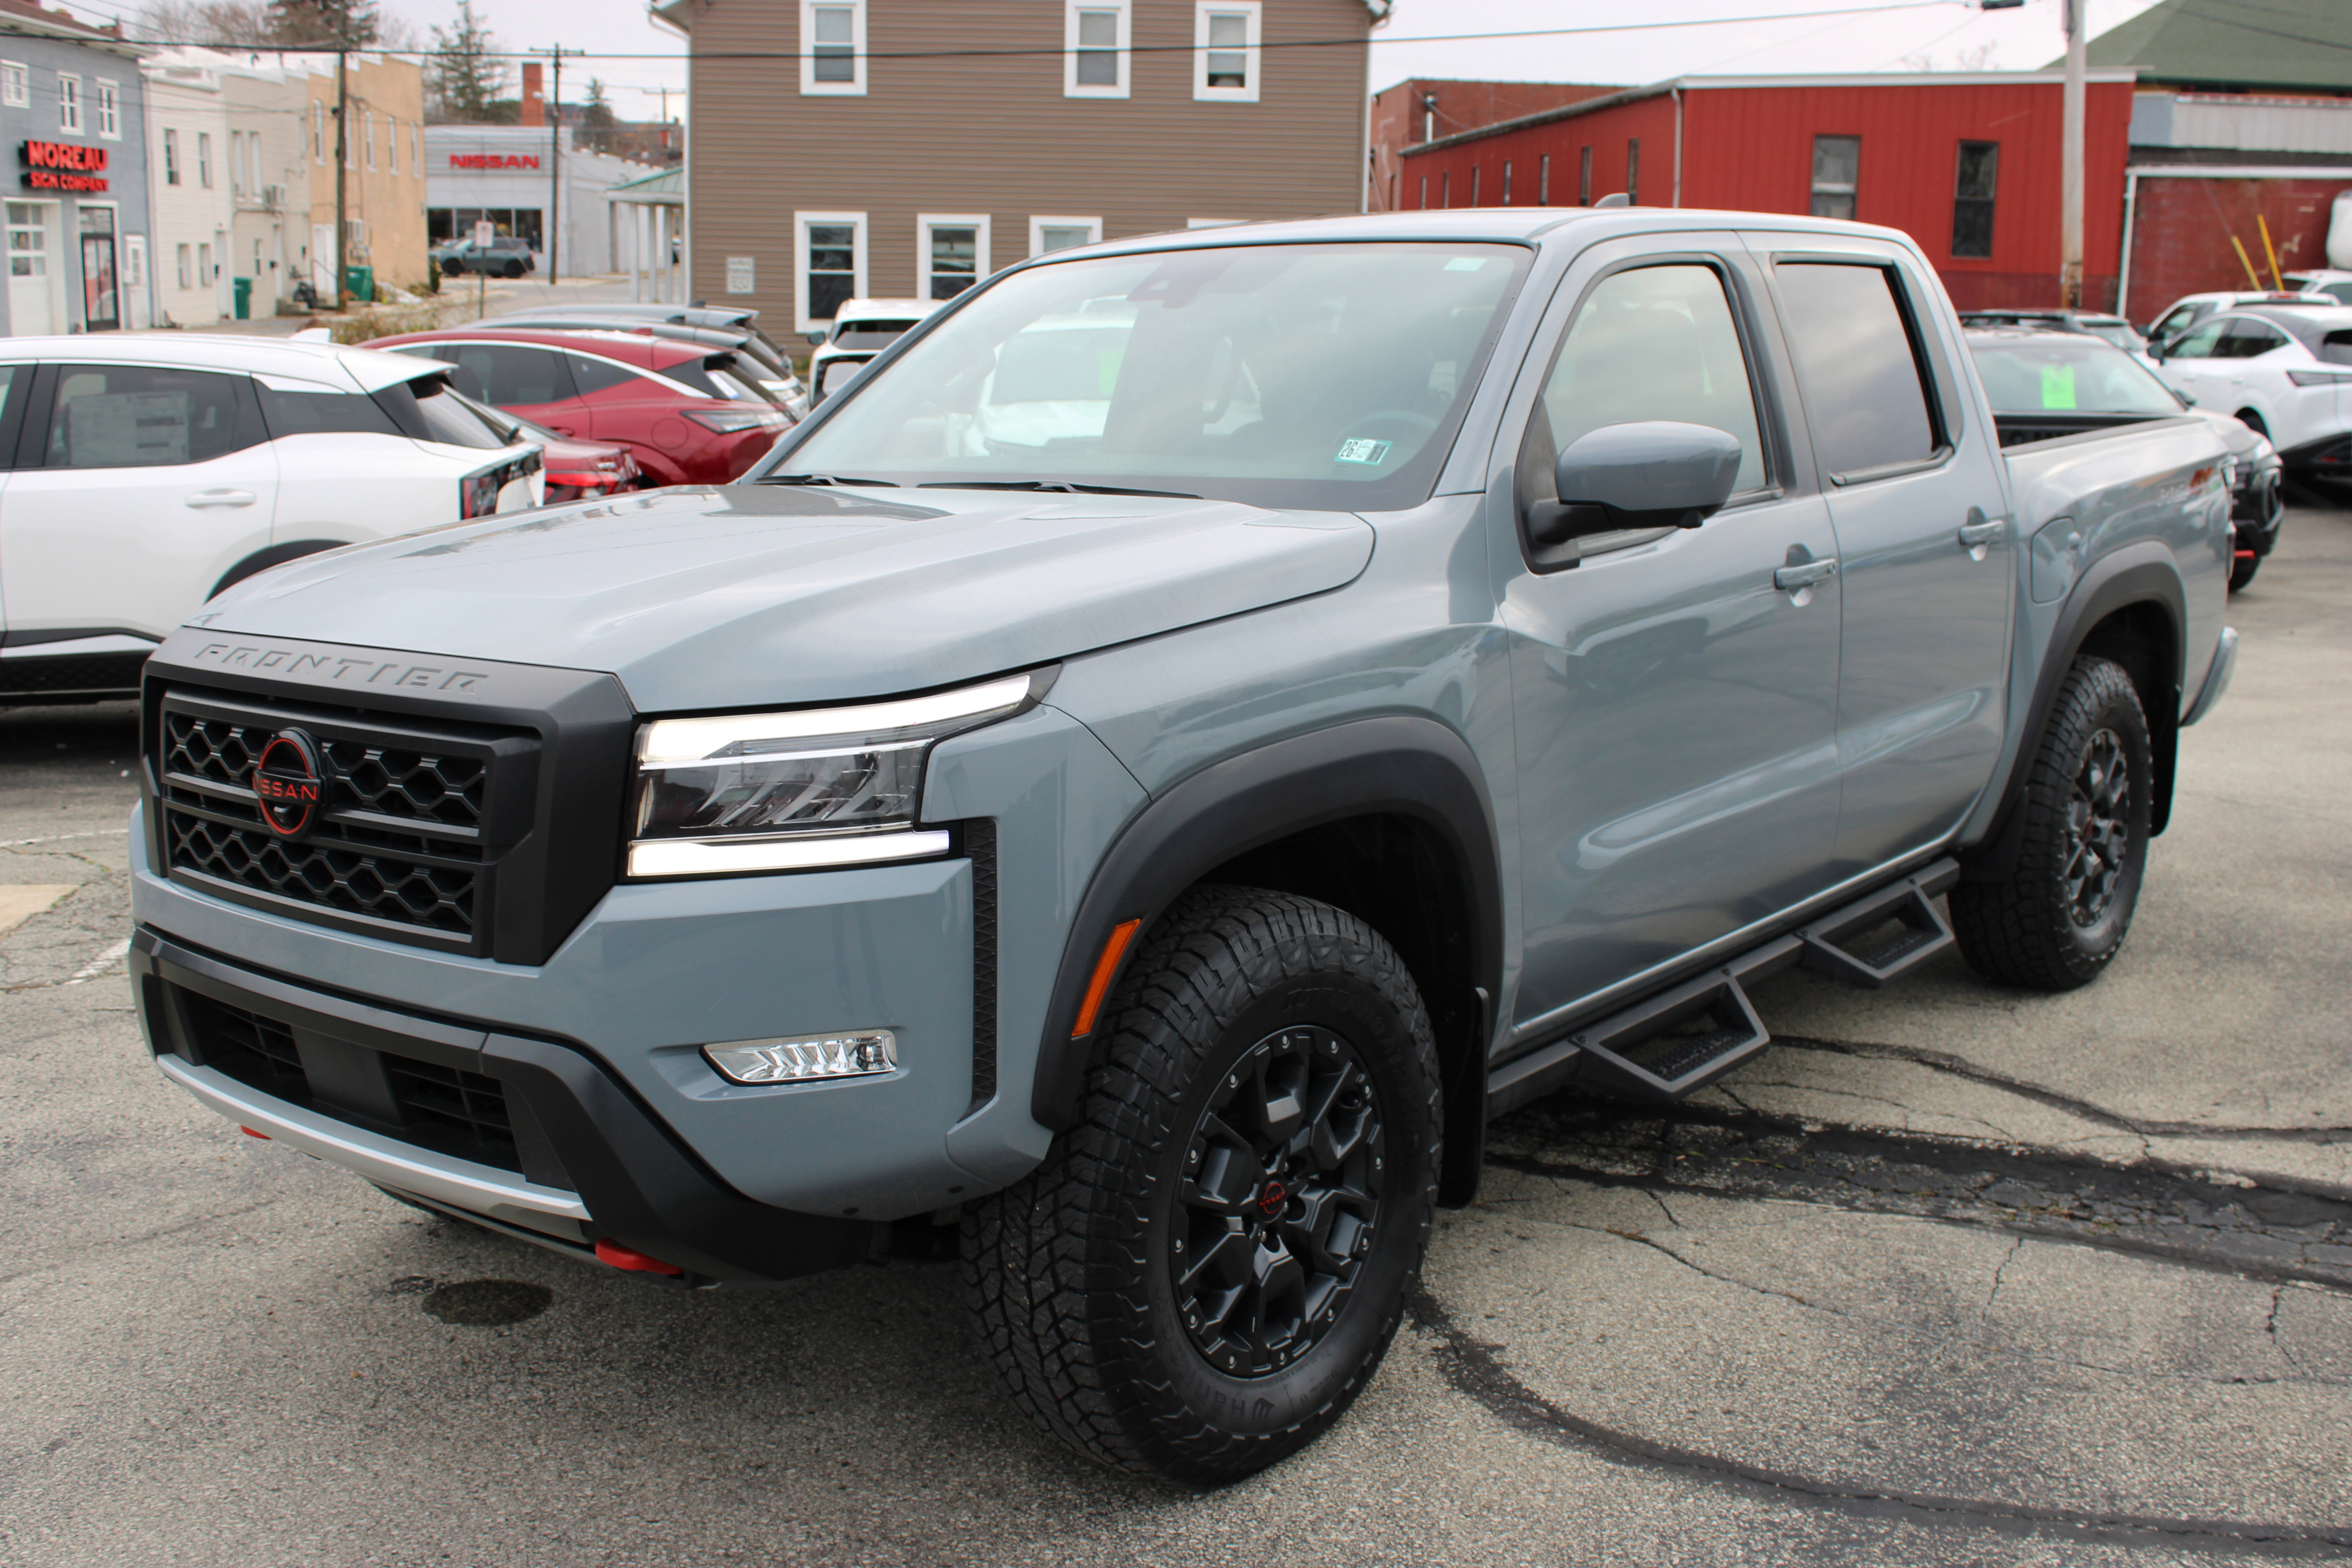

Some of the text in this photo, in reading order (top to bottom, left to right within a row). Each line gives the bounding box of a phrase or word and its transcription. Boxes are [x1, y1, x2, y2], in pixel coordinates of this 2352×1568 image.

[28, 140, 109, 171] MOREAU
[449, 154, 539, 169] NISSAN
[30, 172, 110, 192] SIGN COMPANY
[1340, 441, 1359, 457] 26
[194, 643, 489, 694] FRONTIER
